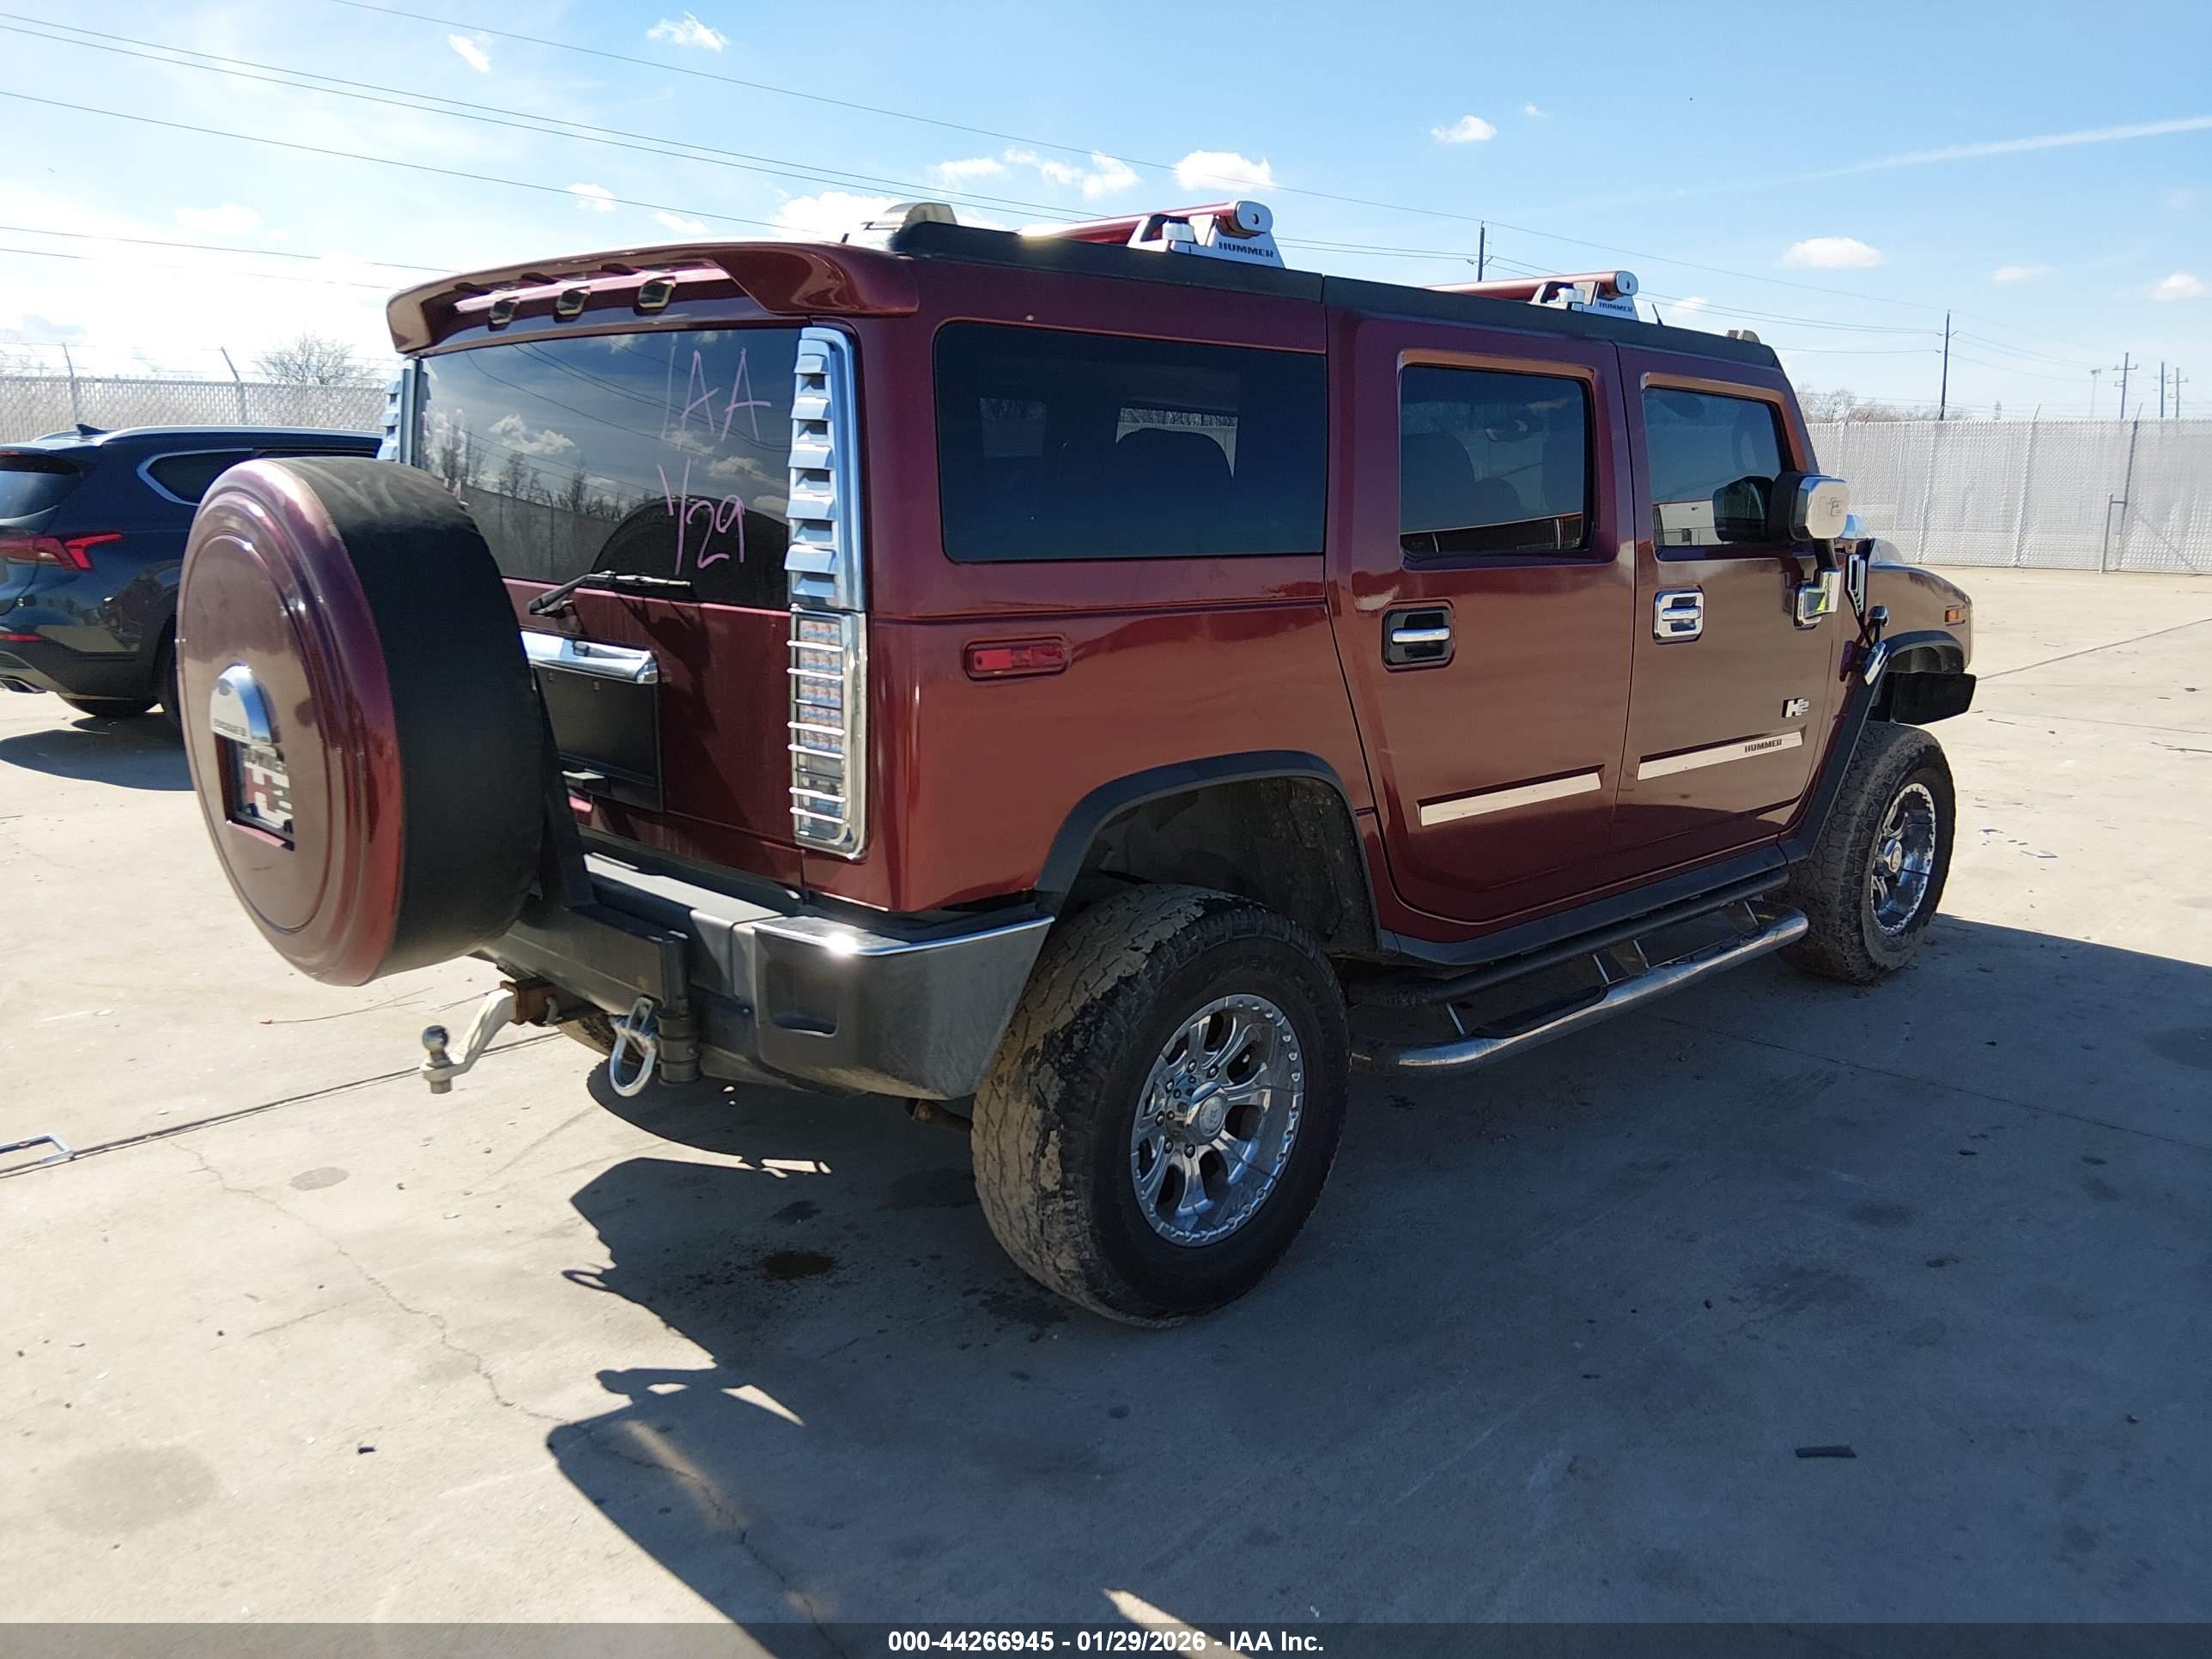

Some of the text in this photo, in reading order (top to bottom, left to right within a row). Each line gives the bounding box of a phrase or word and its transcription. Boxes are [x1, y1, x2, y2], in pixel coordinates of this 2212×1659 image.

[1218, 241, 1274, 258] HUMMER
[1599, 301, 1632, 312] HUMMER
[656, 458, 746, 576] 1/29
[1782, 698, 1810, 719] H2
[1744, 738, 1783, 753] HUMMER
